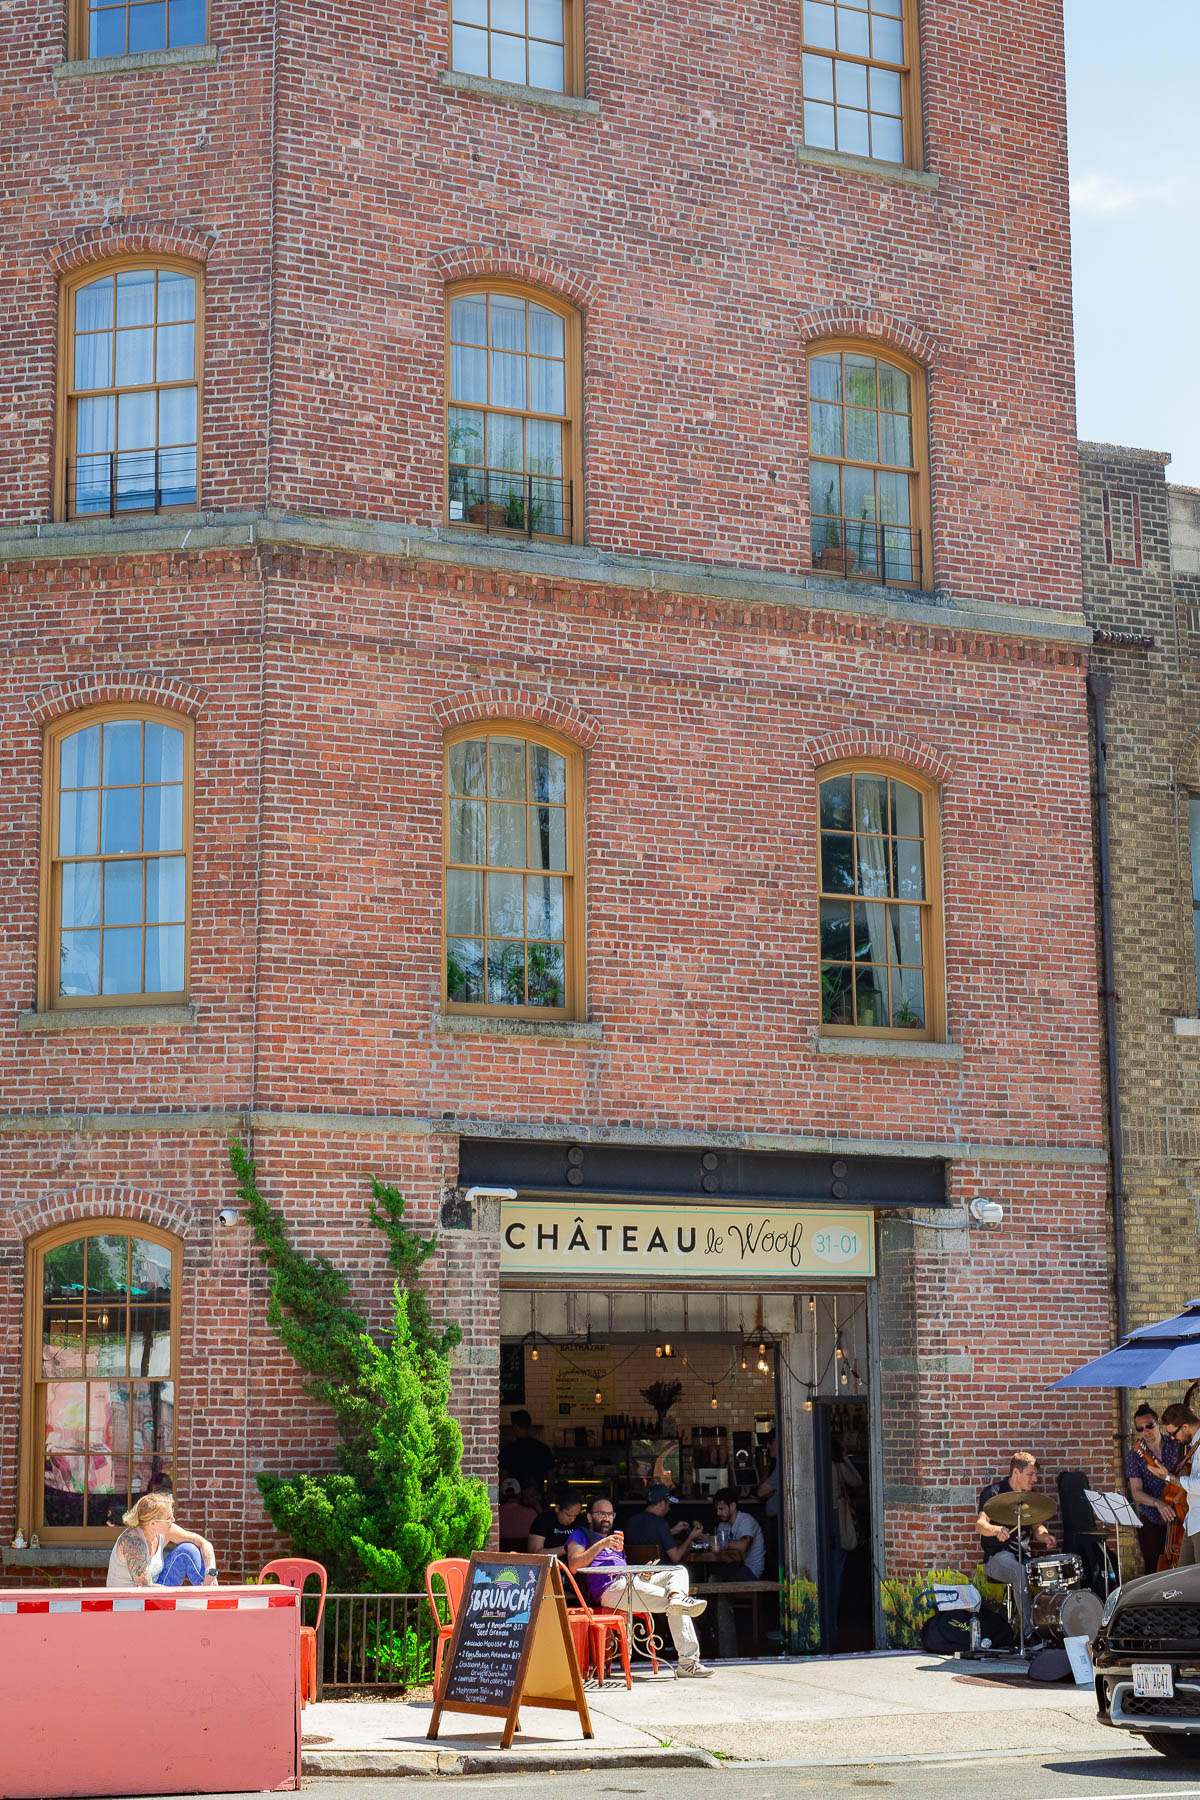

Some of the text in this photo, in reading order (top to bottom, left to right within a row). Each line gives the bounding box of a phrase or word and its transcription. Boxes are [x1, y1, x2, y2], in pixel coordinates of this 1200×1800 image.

[505, 1217, 858, 1268] CHÂTEAU le Woof 31-01
[472, 1588, 530, 1611] BRUNCH
